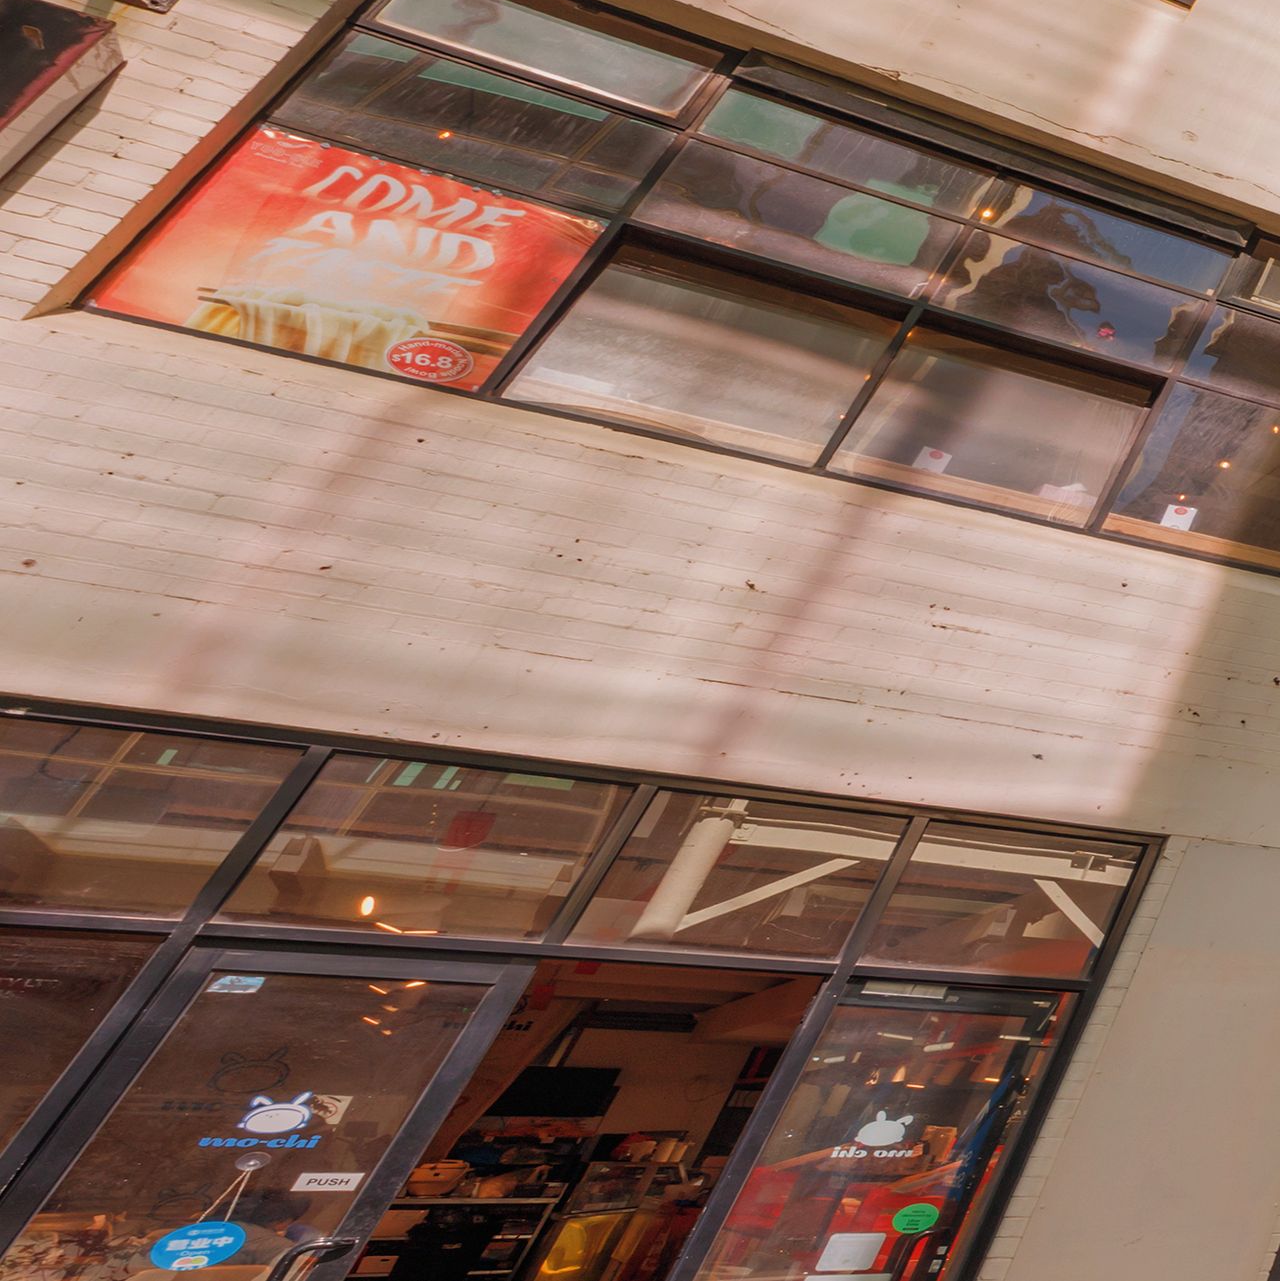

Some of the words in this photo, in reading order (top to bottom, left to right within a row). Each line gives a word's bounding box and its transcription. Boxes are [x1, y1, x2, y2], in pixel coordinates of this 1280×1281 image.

[302, 165, 527, 232] COME
[285, 210, 496, 273] AND
[198, 1134, 321, 1149] mo-chi
[305, 1177, 351, 1187] PUSH
